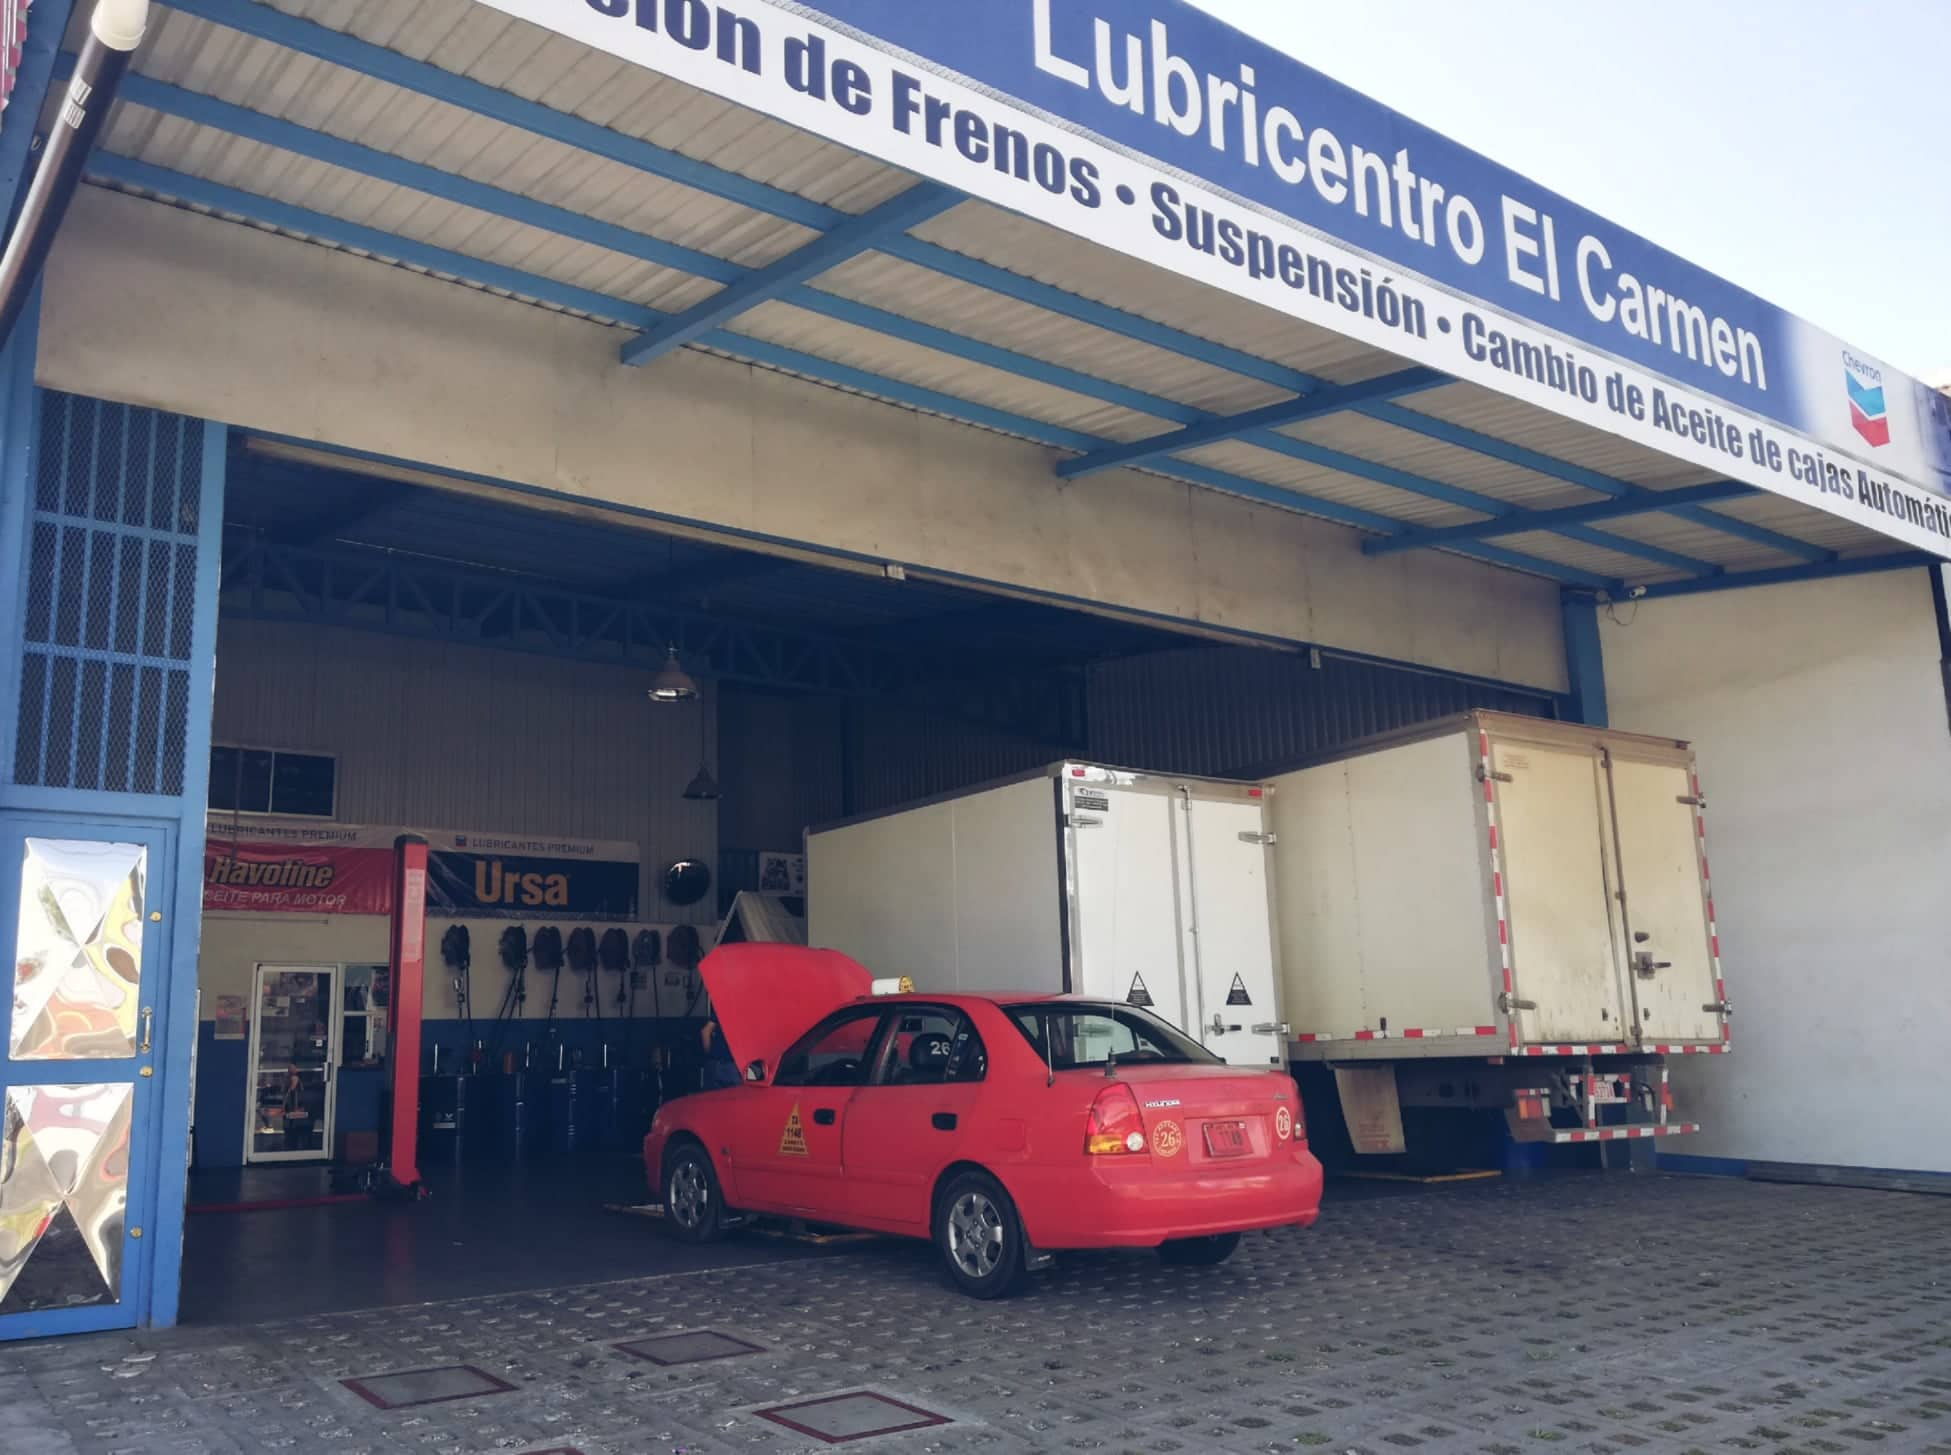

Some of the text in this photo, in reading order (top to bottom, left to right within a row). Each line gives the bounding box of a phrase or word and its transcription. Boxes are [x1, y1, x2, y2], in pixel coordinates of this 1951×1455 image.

[1031, 0, 1768, 391] Lubricentro El Carmen
[783, 33, 872, 117] de
[891, 69, 1101, 209] Frenos
[1150, 181, 1427, 339] Suspensión
[1462, 312, 1598, 404] Cambio
[1605, 370, 1645, 420] de
[1652, 387, 1743, 459] Aceite
[1748, 428, 1782, 473] de
[1788, 448, 1854, 500] cajas
[1857, 469, 1951, 538] Automáti
[1842, 349, 1882, 383] Chevron
[301, 829, 358, 841] PREMIUM
[472, 838, 595, 855] LUBRICANTES PREMIUM
[209, 855, 335, 888] Havoline
[475, 860, 568, 905] Ursa
[251, 891, 290, 904] PARA
[294, 894, 347, 906] MOTOR
[1160, 1130, 1176, 1148] 26
